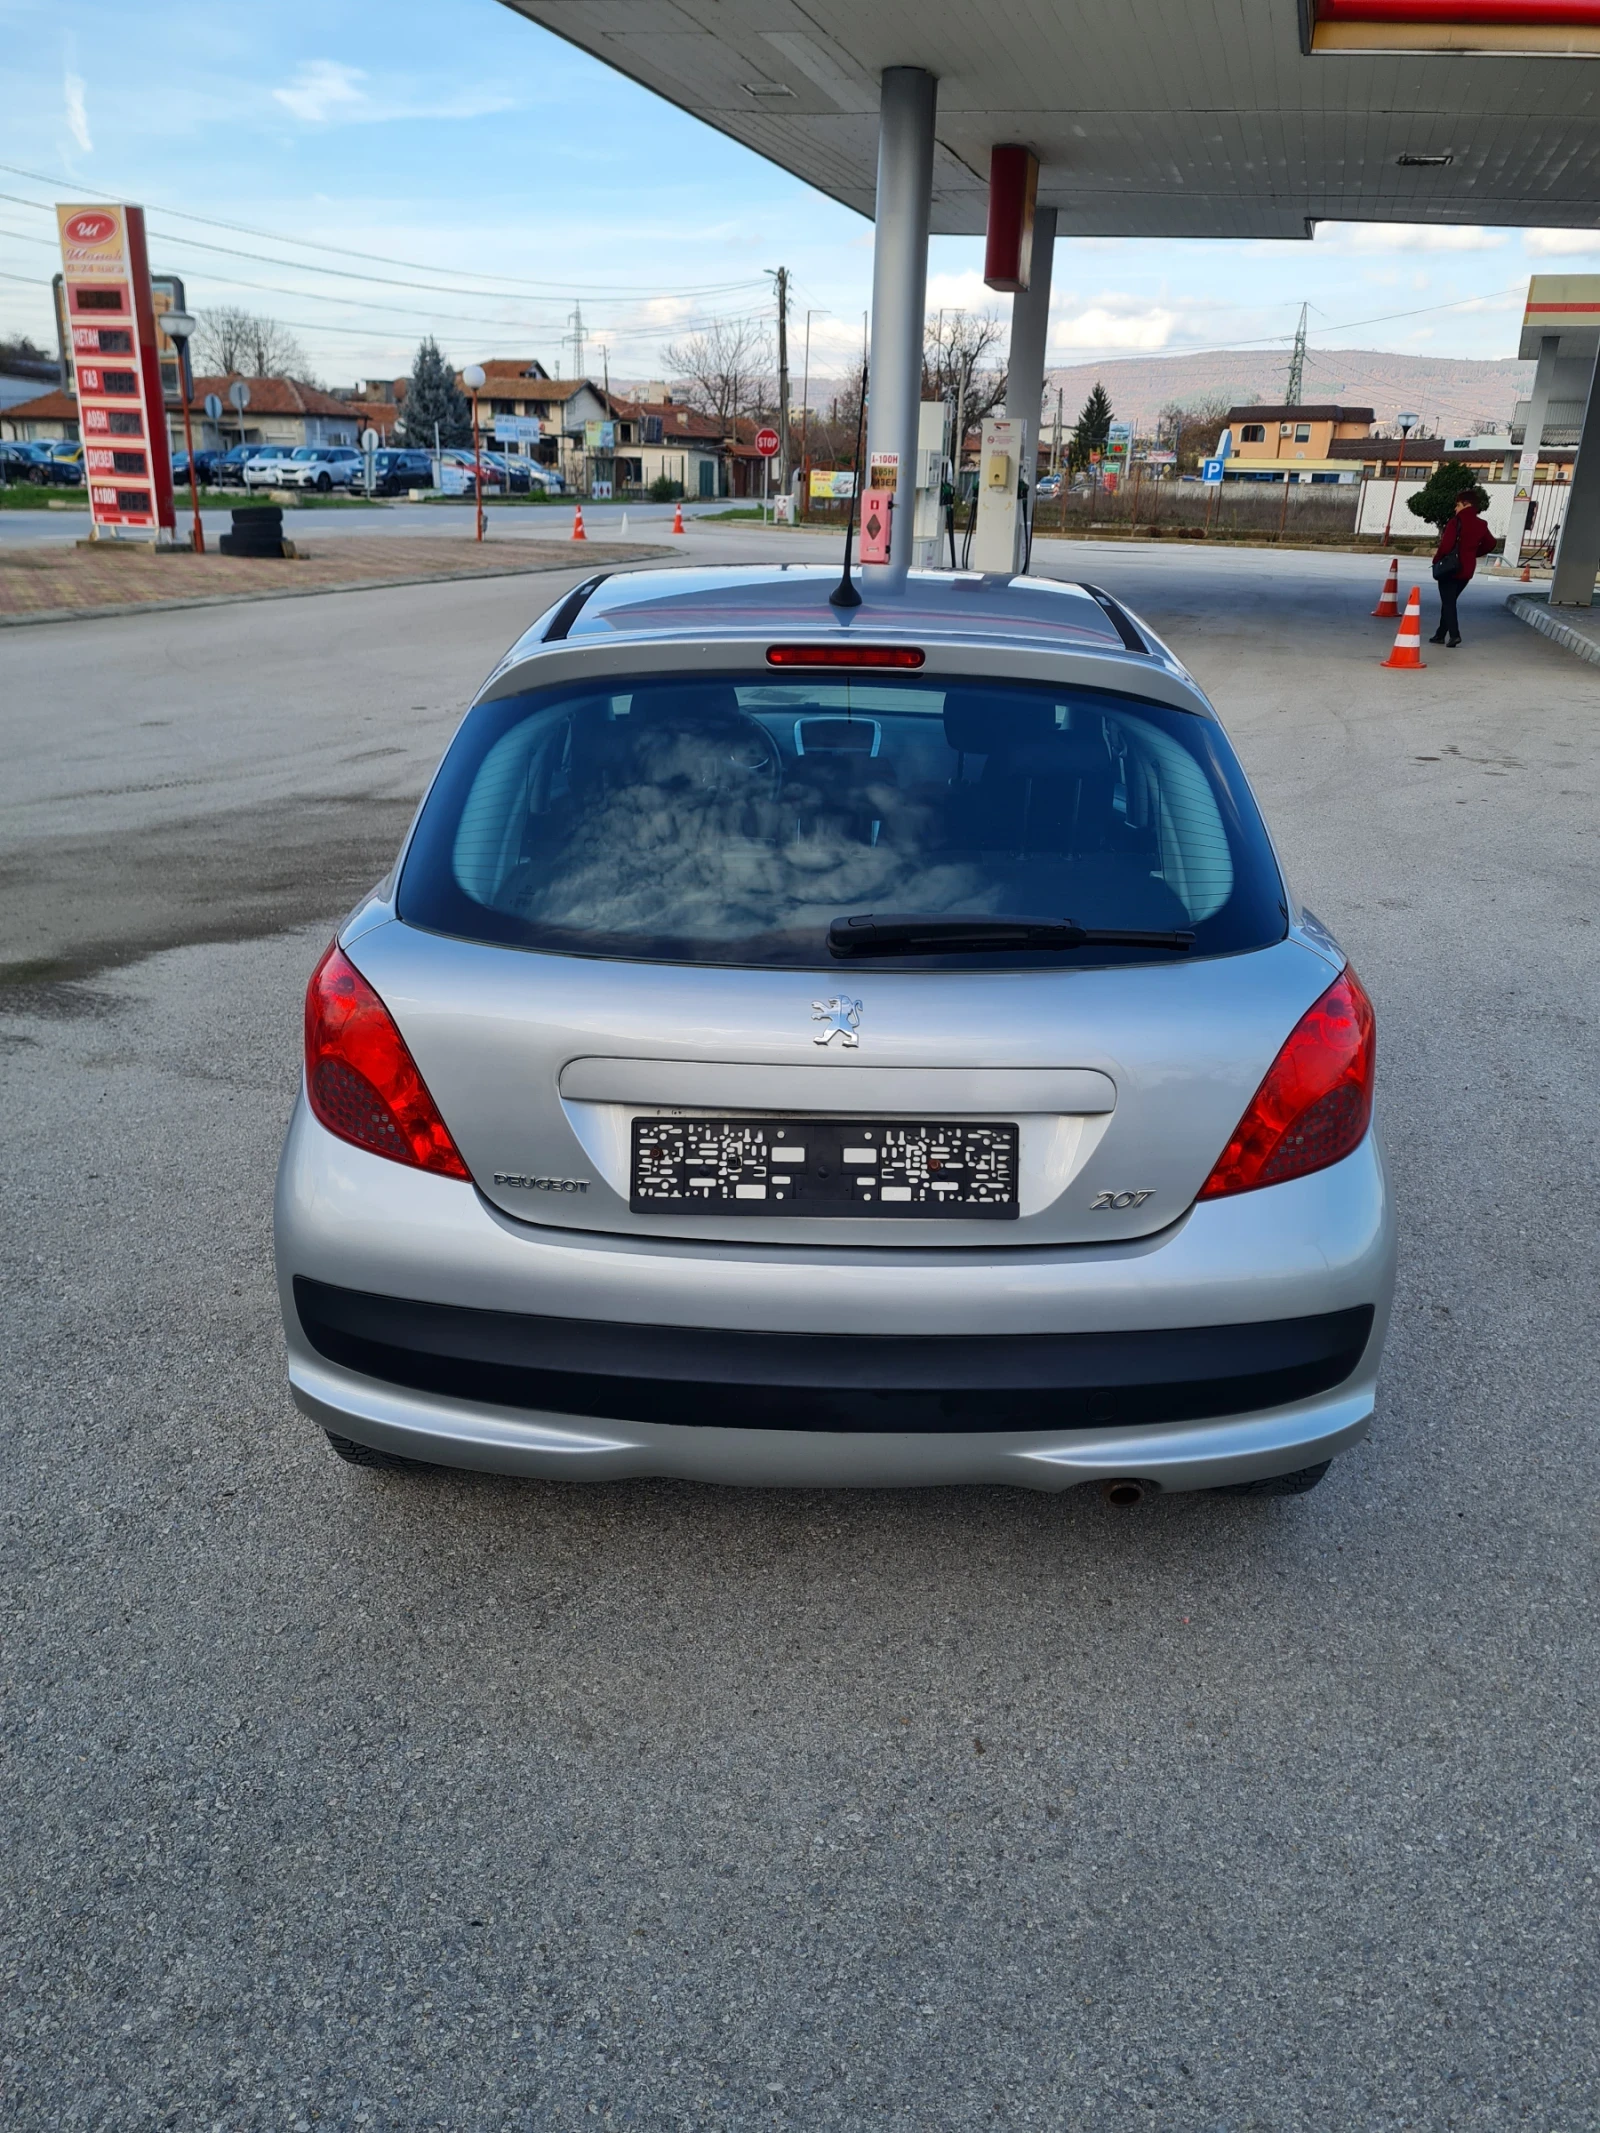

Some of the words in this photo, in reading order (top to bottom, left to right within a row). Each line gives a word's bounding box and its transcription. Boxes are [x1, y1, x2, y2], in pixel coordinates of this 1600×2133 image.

[82, 369, 98, 389] ГАЗ
[758, 436, 778, 448] STOP
[87, 448, 115, 470] ДИЗЕЛ
[493, 1171, 591, 1194] PEUGEOT
[1090, 1188, 1157, 1210] 207
